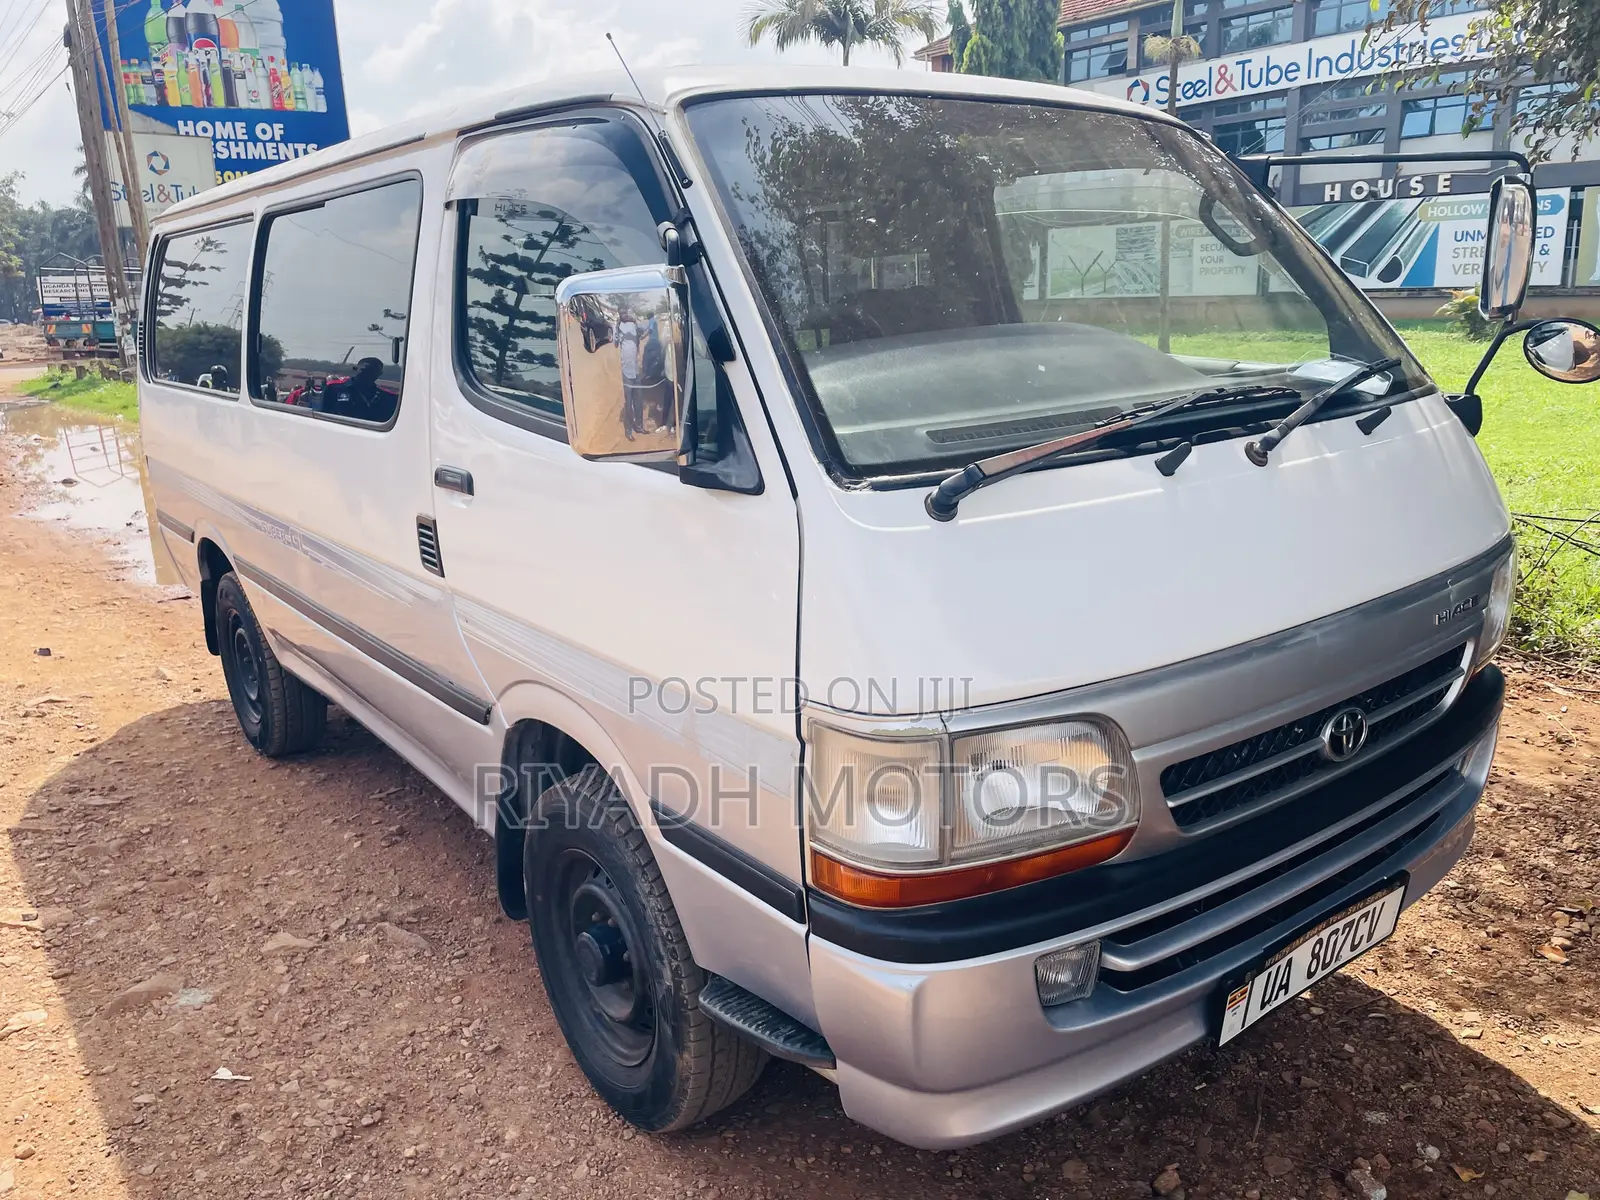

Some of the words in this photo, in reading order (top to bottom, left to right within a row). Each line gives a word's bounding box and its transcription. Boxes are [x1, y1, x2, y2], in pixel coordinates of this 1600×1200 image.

[1307, 33, 1466, 80] Industries
[177, 120, 248, 140] HOME
[254, 122, 284, 141] OF
[1324, 173, 1452, 202] HOUSE
[1427, 204, 1484, 217] HOLLOW
[1200, 255, 1224, 264] YOUR
[1199, 265, 1246, 276] PROPERTY
[1260, 957, 1293, 1012] UA
[1306, 901, 1386, 980] 807CV
